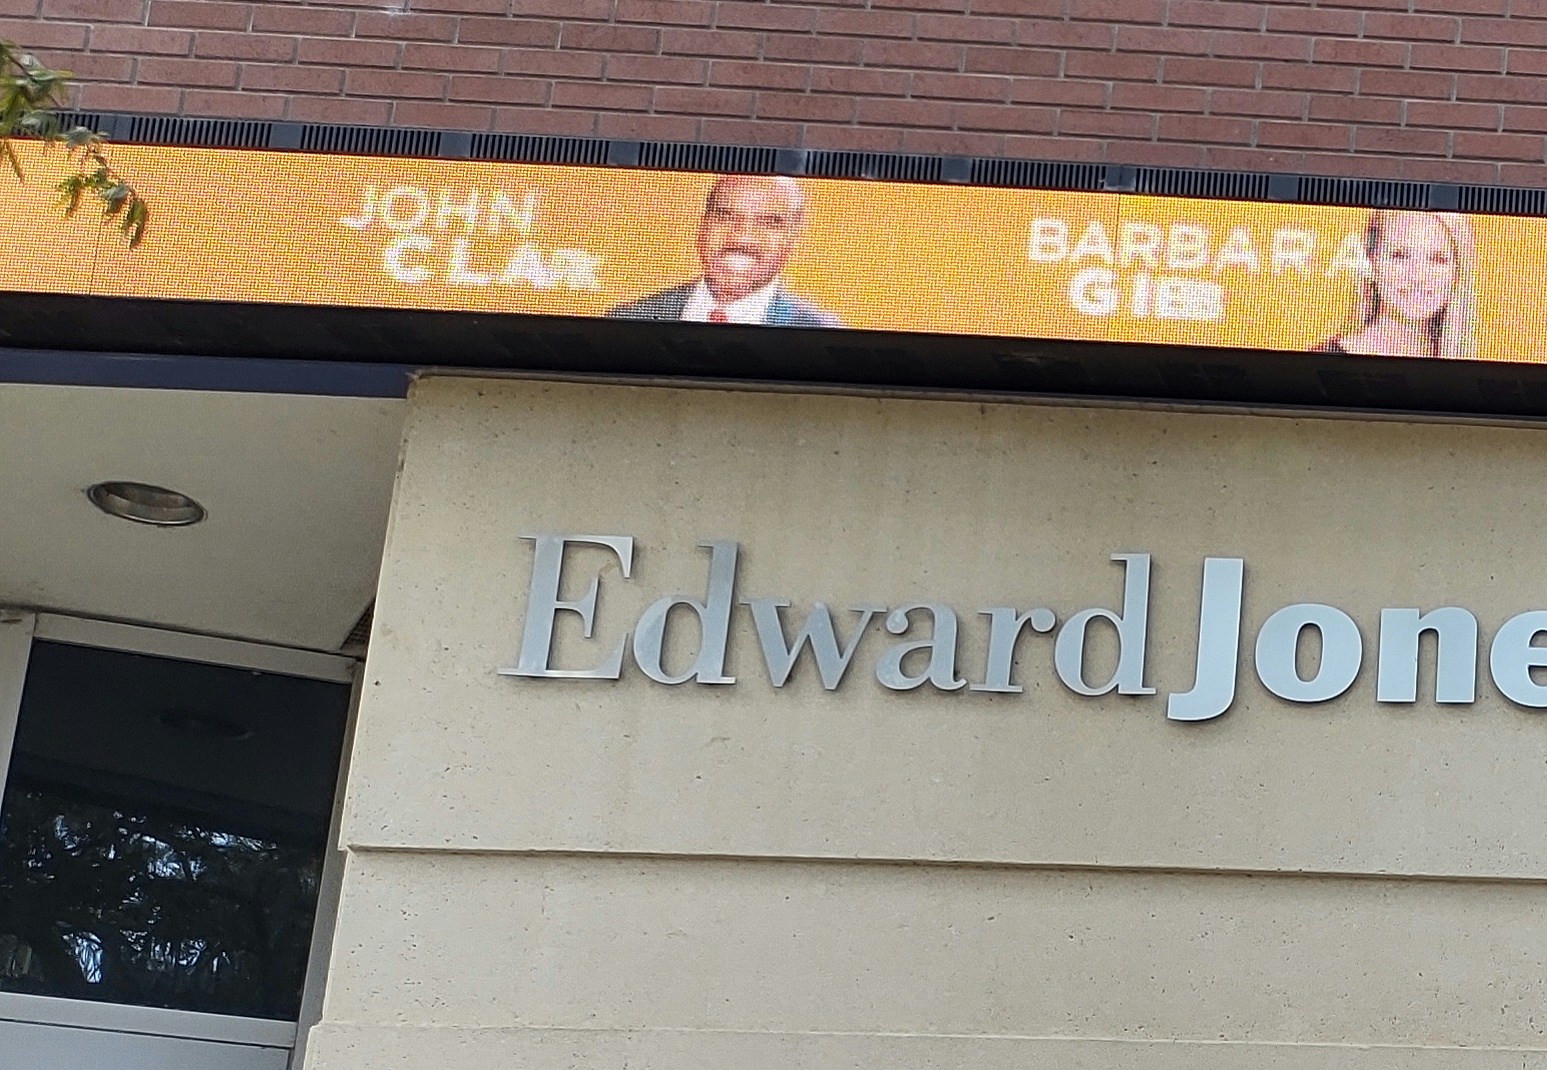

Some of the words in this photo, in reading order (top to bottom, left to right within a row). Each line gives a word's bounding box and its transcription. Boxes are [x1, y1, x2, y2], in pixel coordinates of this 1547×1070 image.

[339, 183, 539, 235] JOHN
[1028, 216, 1374, 278] BARBARA
[497, 534, 1157, 698] Edward
